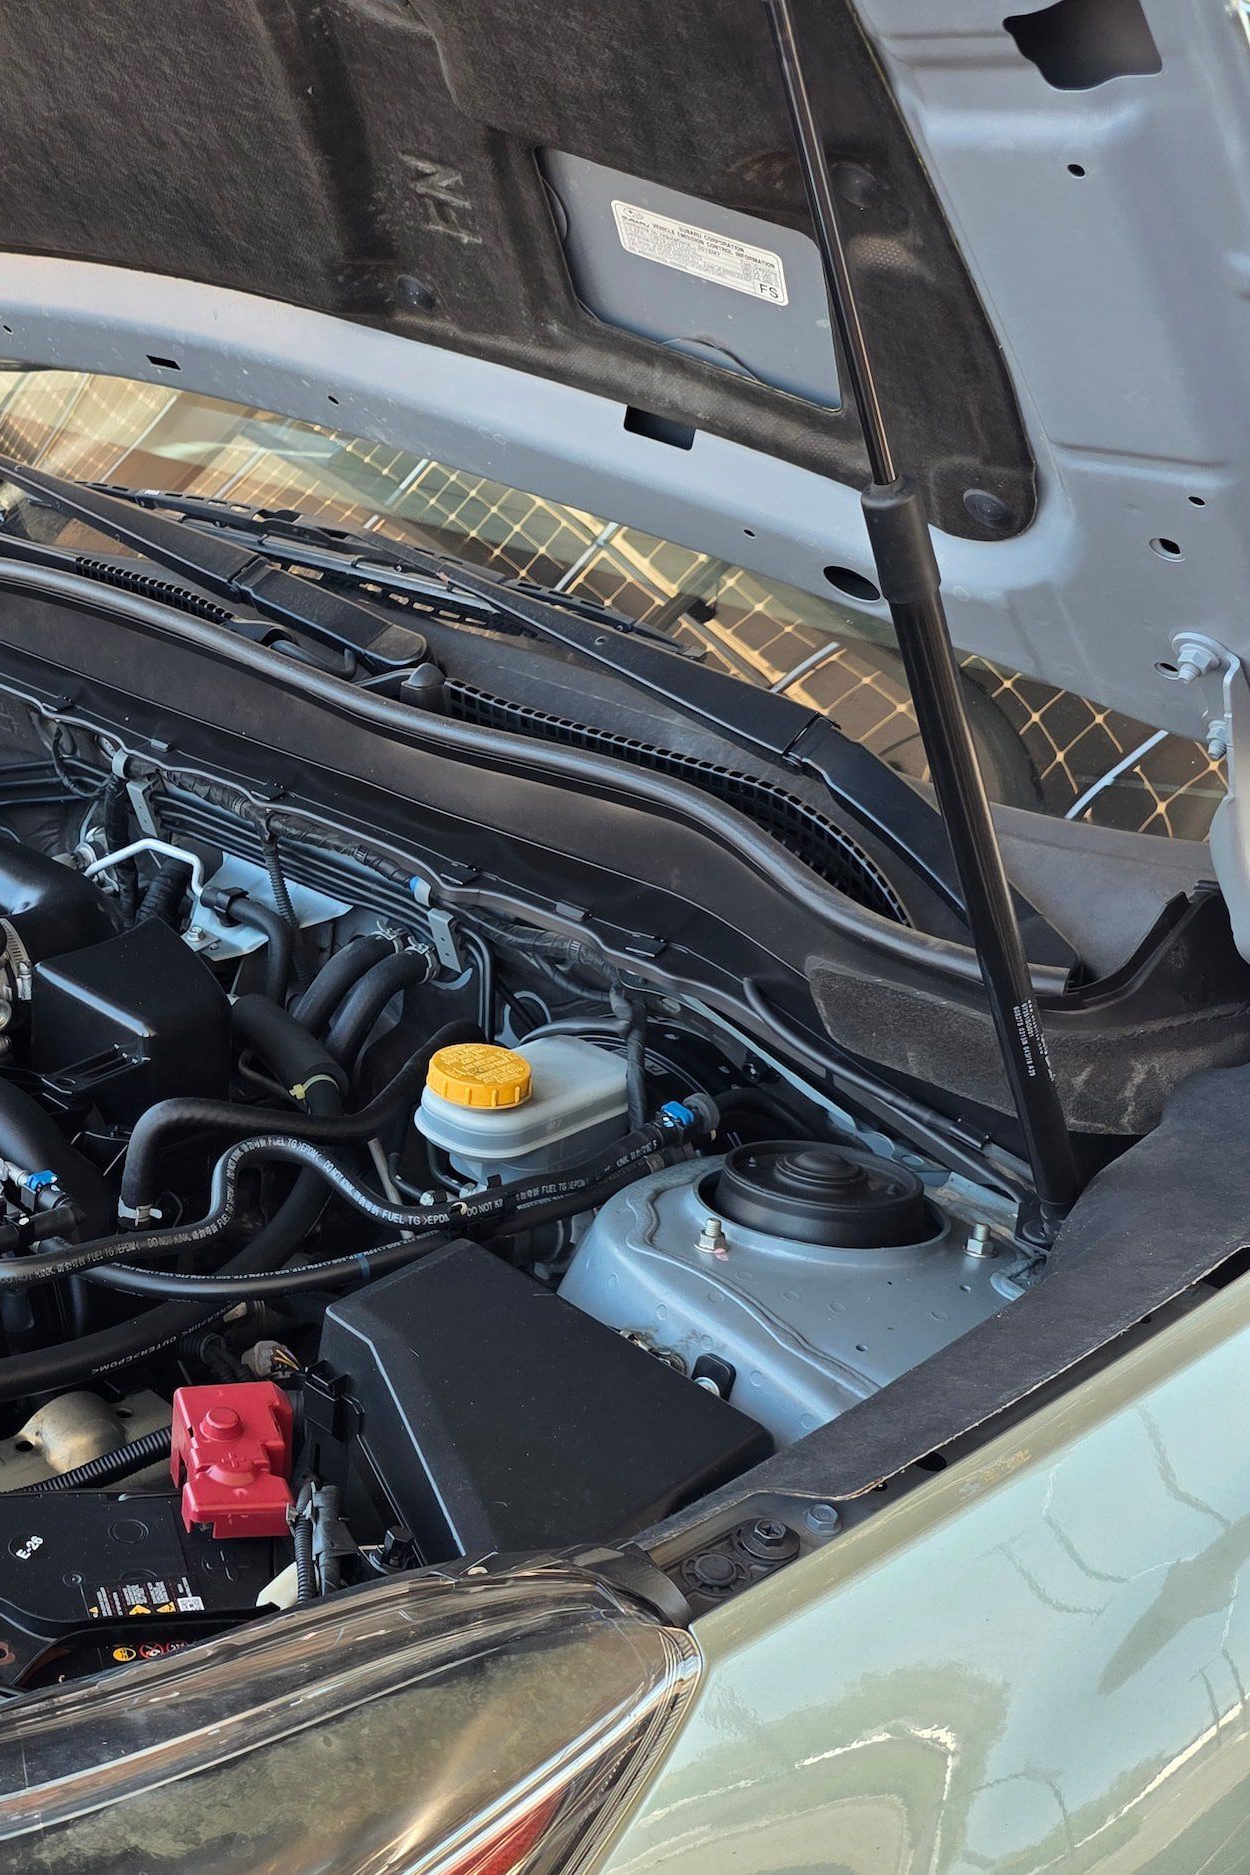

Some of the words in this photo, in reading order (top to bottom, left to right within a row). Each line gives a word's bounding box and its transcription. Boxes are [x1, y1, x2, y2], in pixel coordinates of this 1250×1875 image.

[758, 283, 779, 299] FS
[266, 1137, 286, 1147] FUEL
[286, 1138, 298, 1149] TG
[323, 1160, 335, 1174] DO
[330, 1167, 345, 1183] NOT
[381, 1209, 405, 1225] FUEL
[407, 1214, 421, 1226] TG
[541, 1183, 558, 1195] FUEL
[559, 1181, 568, 1192] TG
[466, 1205, 479, 1217] DO
[478, 1202, 492, 1213] NOT
[146, 1237, 158, 1249] DO
[216, 1212, 232, 1229] FUEL
[15, 1535, 44, 1560] E-26
